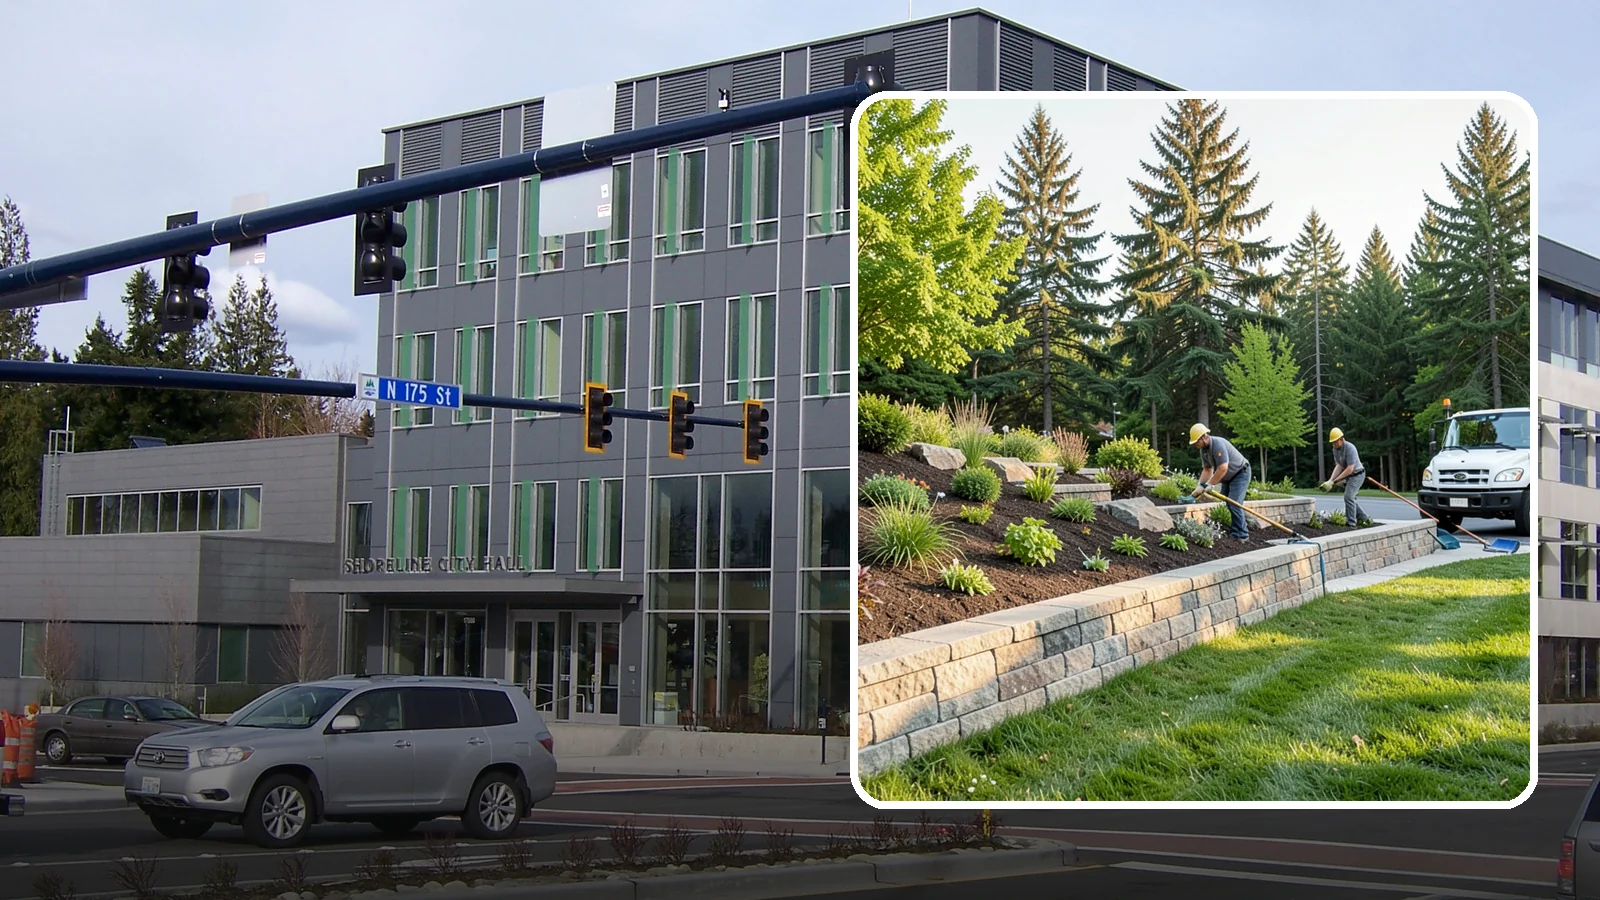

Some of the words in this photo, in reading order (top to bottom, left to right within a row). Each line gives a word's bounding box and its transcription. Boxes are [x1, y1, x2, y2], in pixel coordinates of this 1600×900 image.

[387, 380, 396, 400] N
[405, 382, 427, 403] 175
[436, 386, 451, 406] St
[344, 557, 432, 574] SHORELINE
[438, 556, 475, 573] CITY
[484, 555, 525, 572] HALL
